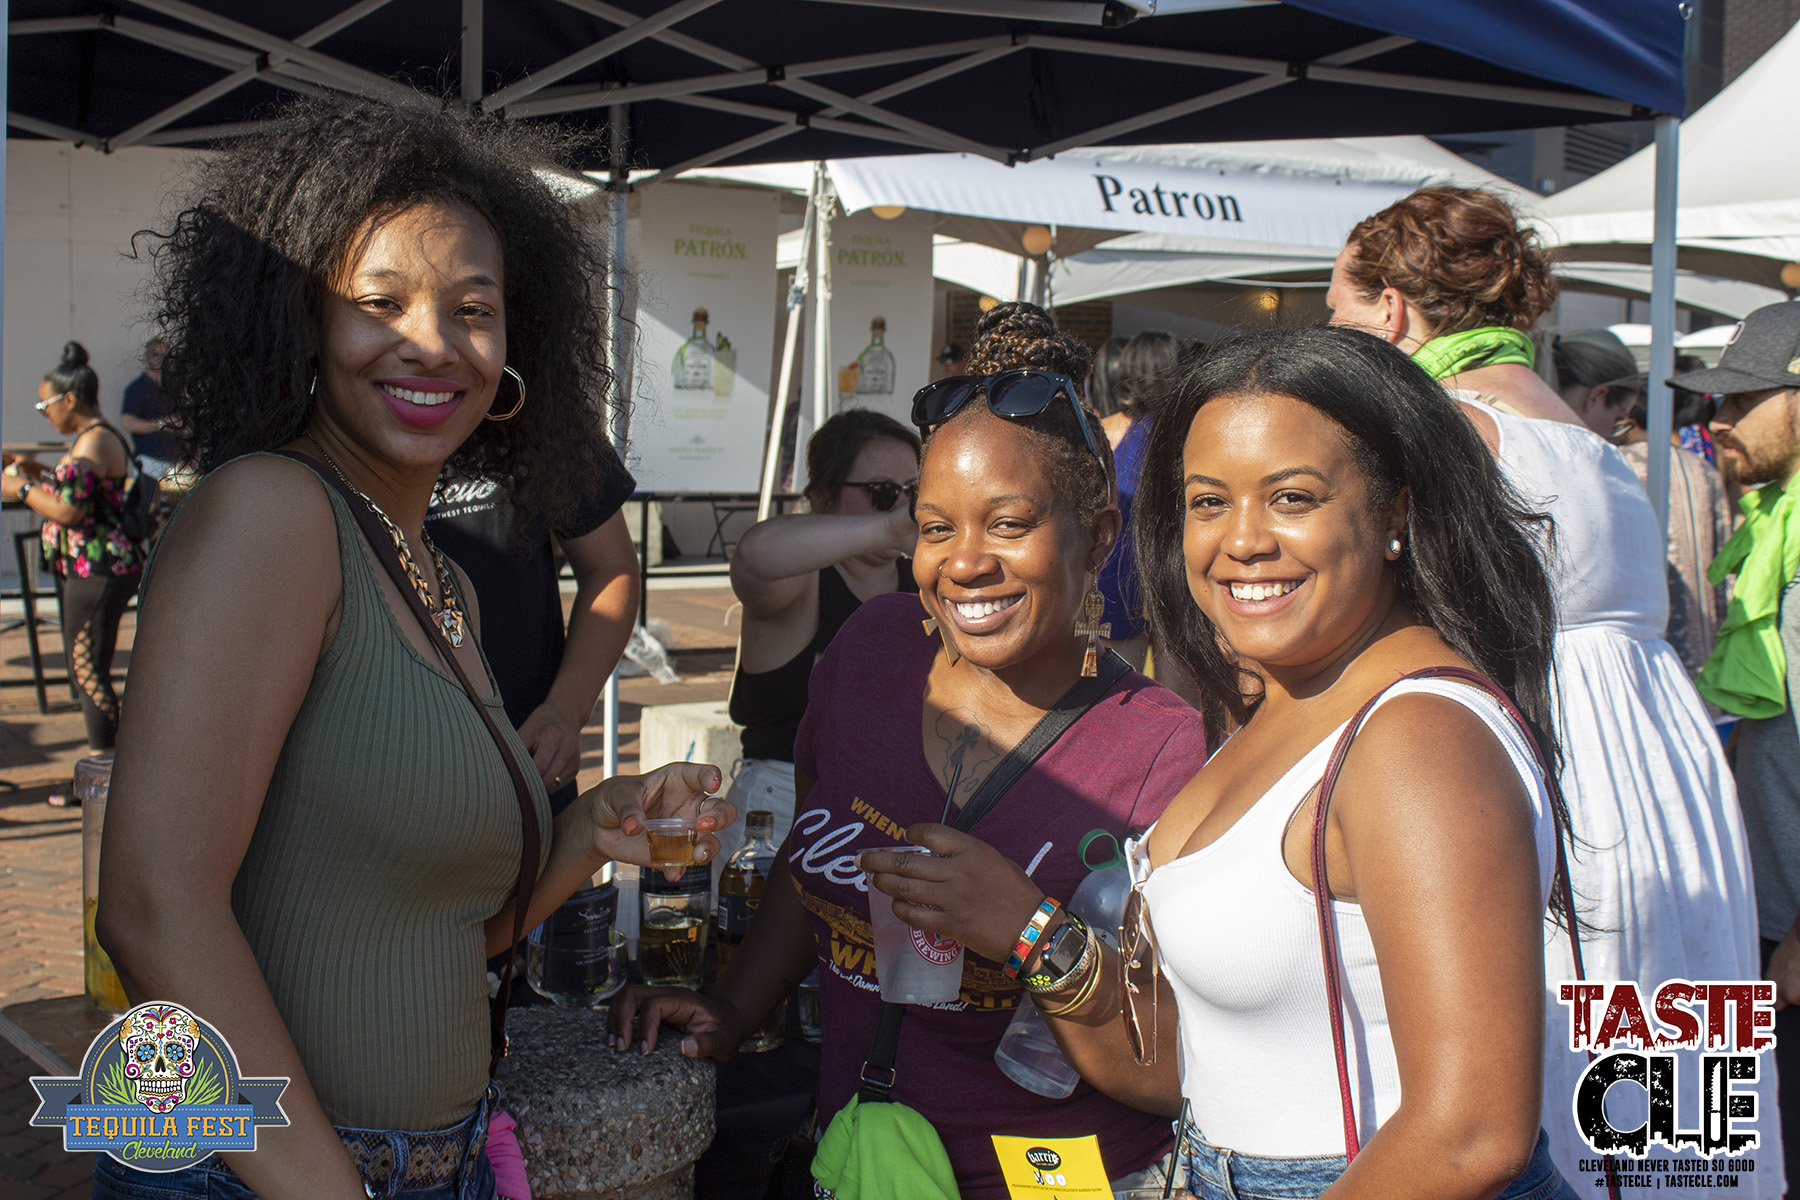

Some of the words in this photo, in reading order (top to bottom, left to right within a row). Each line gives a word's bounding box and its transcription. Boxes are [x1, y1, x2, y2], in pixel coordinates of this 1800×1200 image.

[1093, 174, 1243, 222] Patron
[690, 224, 732, 237] TEQUILA
[852, 234, 891, 246] TEQUILA
[850, 797, 905, 841] WHEN
[913, 930, 957, 961] BREWING
[852, 975, 881, 993] Damn
